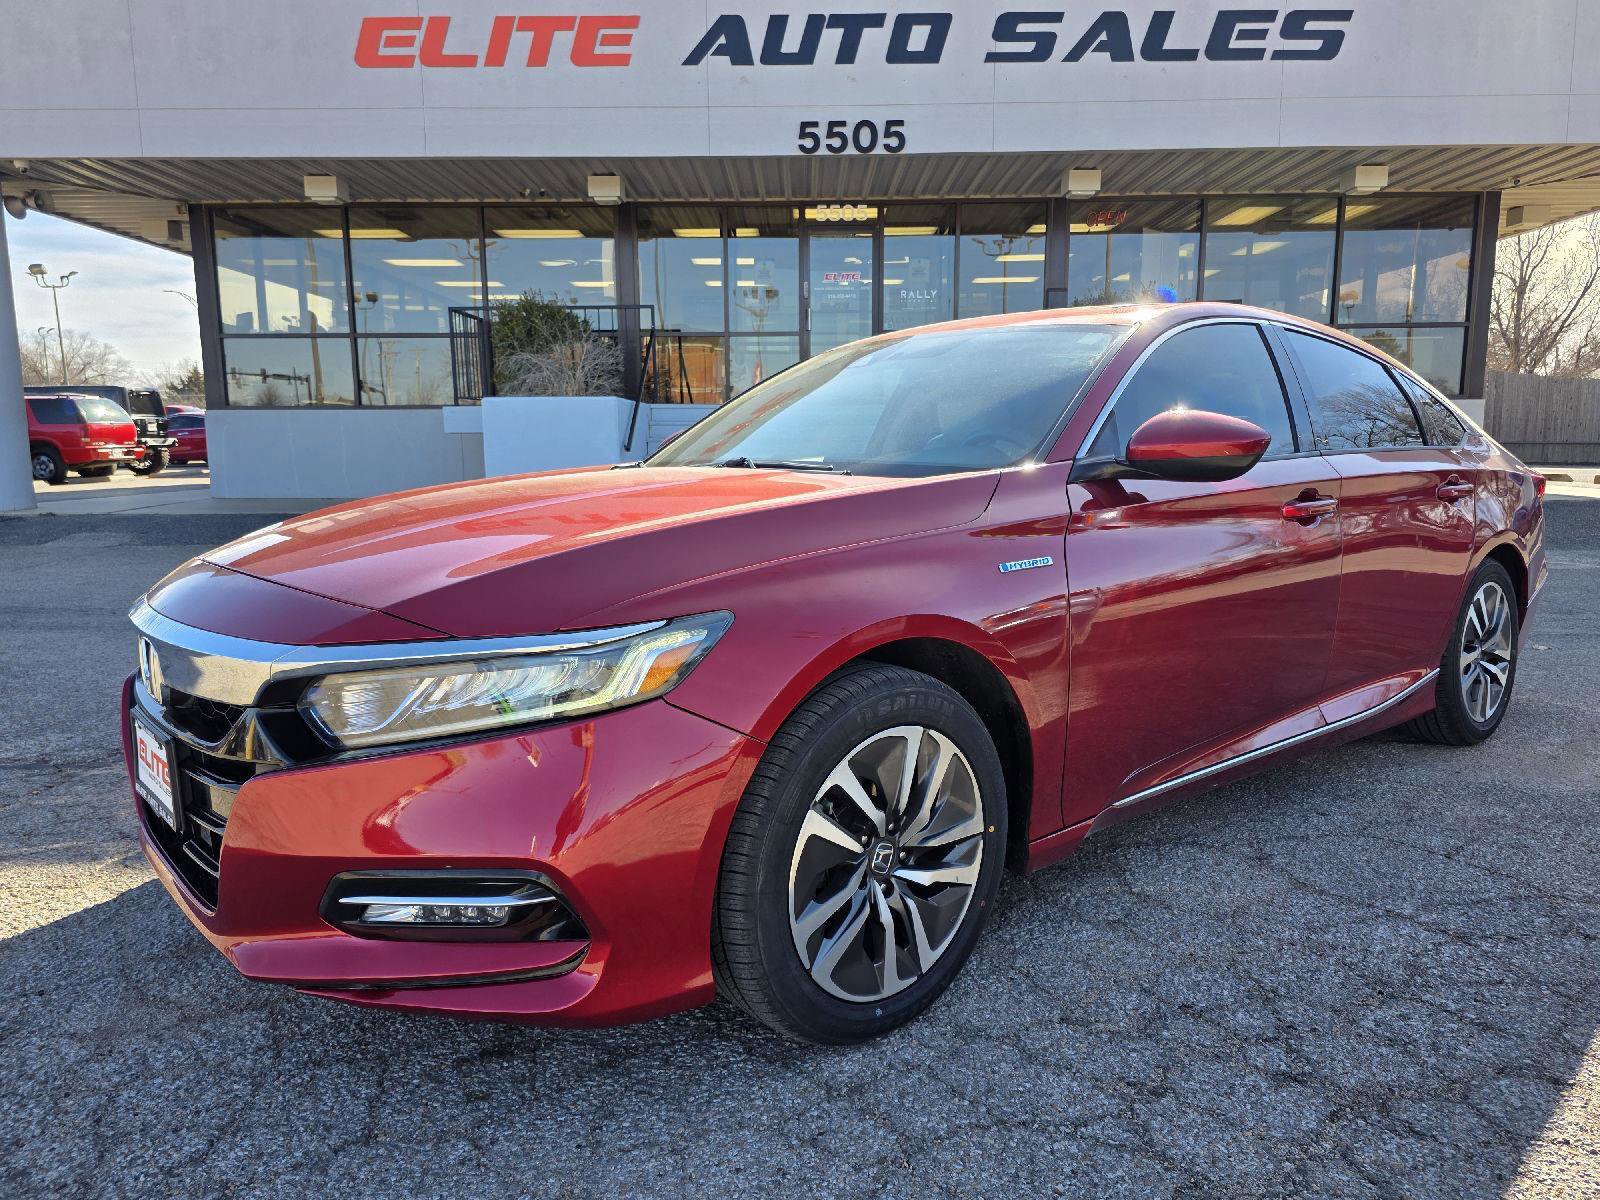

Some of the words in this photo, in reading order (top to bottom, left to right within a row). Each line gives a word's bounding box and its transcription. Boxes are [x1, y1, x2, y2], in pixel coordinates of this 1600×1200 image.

[354, 15, 640, 68] ELITE
[681, 12, 953, 66] AUTO
[984, 9, 1354, 63] SALES
[798, 119, 906, 155] 5505
[815, 204, 868, 222] 5505
[1087, 210, 1128, 228] OPEN
[824, 272, 861, 281] ELITE
[900, 289, 938, 299] RALLY
[1009, 557, 1050, 570] HYBRID
[139, 737, 171, 788] ELITE
